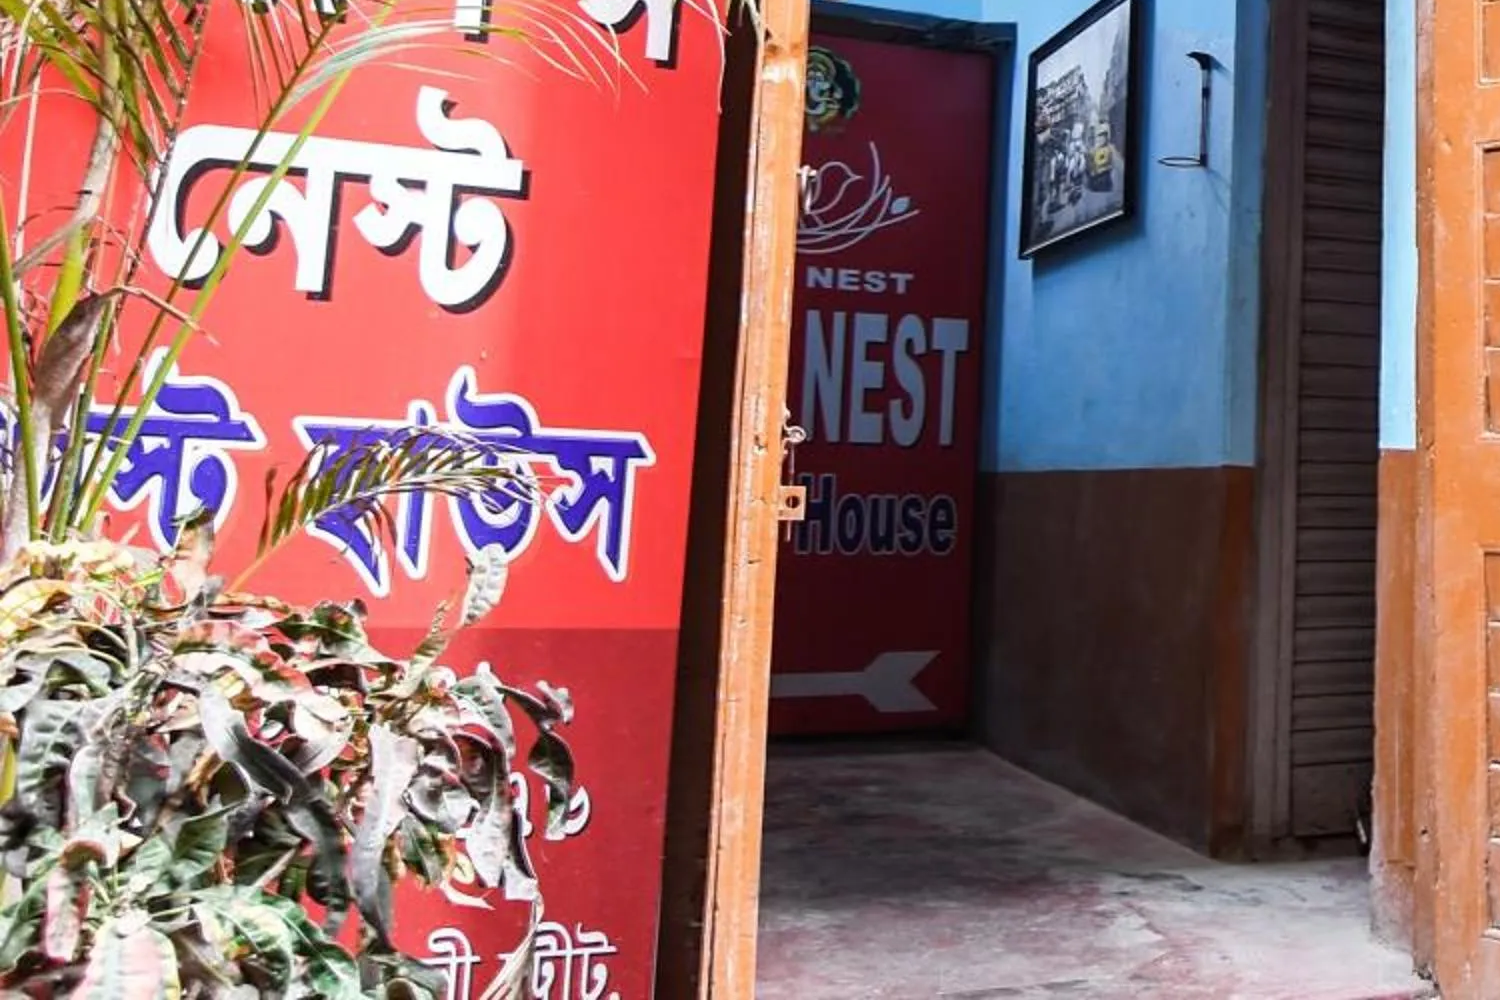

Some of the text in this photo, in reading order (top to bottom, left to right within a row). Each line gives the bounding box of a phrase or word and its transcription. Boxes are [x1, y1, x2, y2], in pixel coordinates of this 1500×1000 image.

[147, 85, 530, 308] নেস্ট
[806, 266, 914, 295] NEST
[801, 308, 970, 447] NEST
[293, 365, 657, 597] হাউস
[794, 473, 957, 556] House
